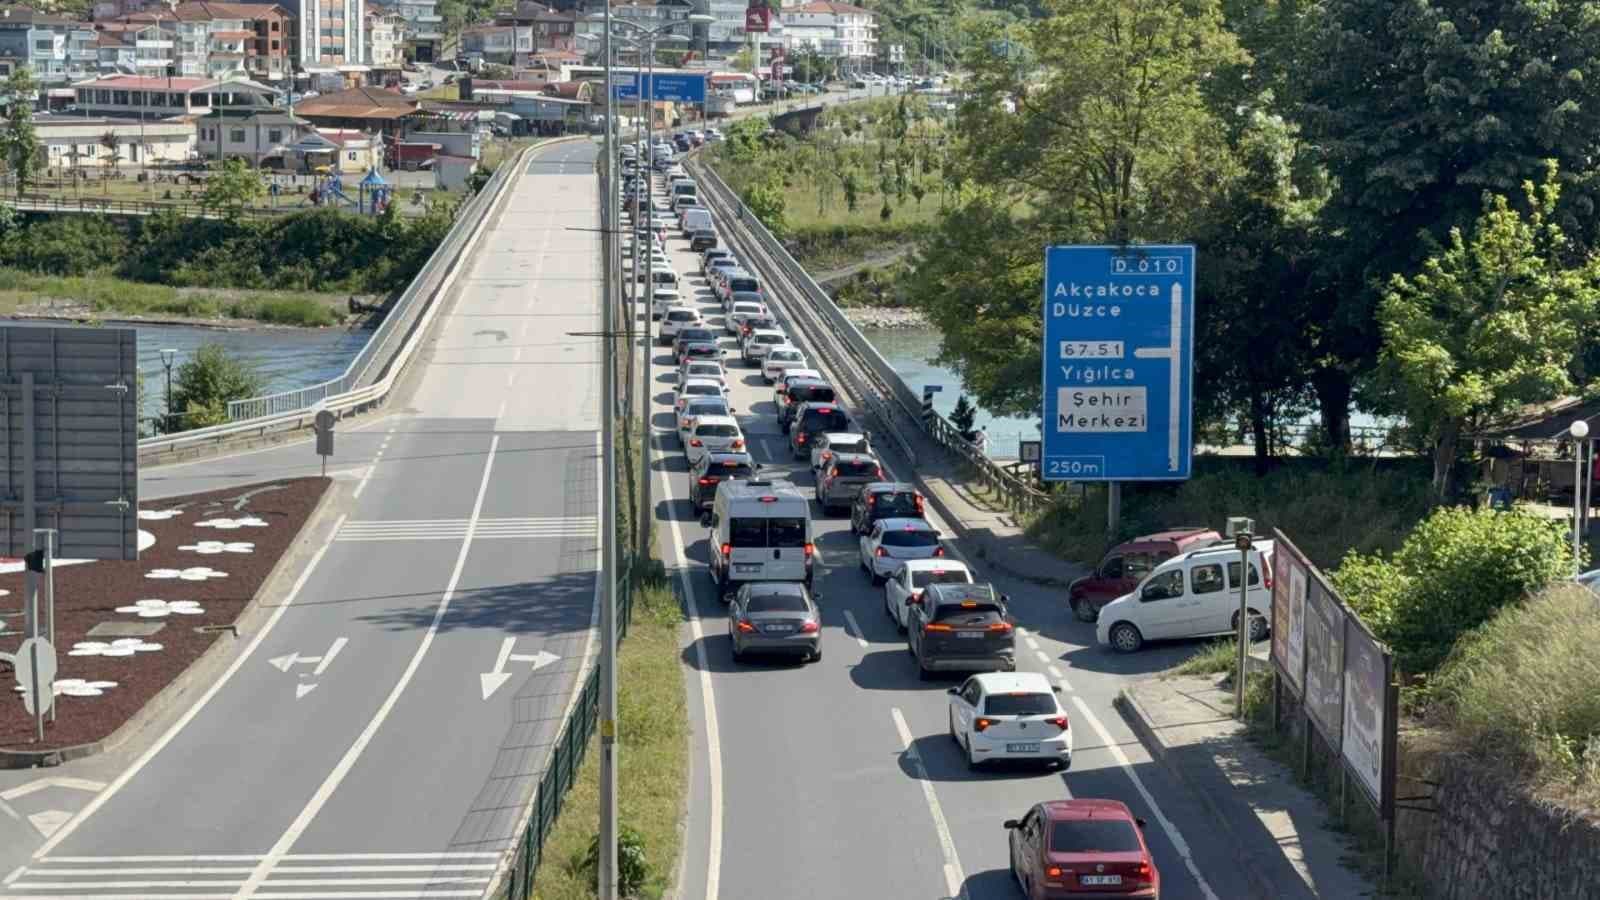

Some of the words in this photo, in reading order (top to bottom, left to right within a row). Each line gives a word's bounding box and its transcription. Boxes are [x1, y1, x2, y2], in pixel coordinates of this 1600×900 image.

[1053, 281, 1160, 299] Akçakoca
[1060, 364, 1136, 383] Yığılca
[1072, 391, 1132, 408] Şehir
[1058, 412, 1145, 428] Merkezi
